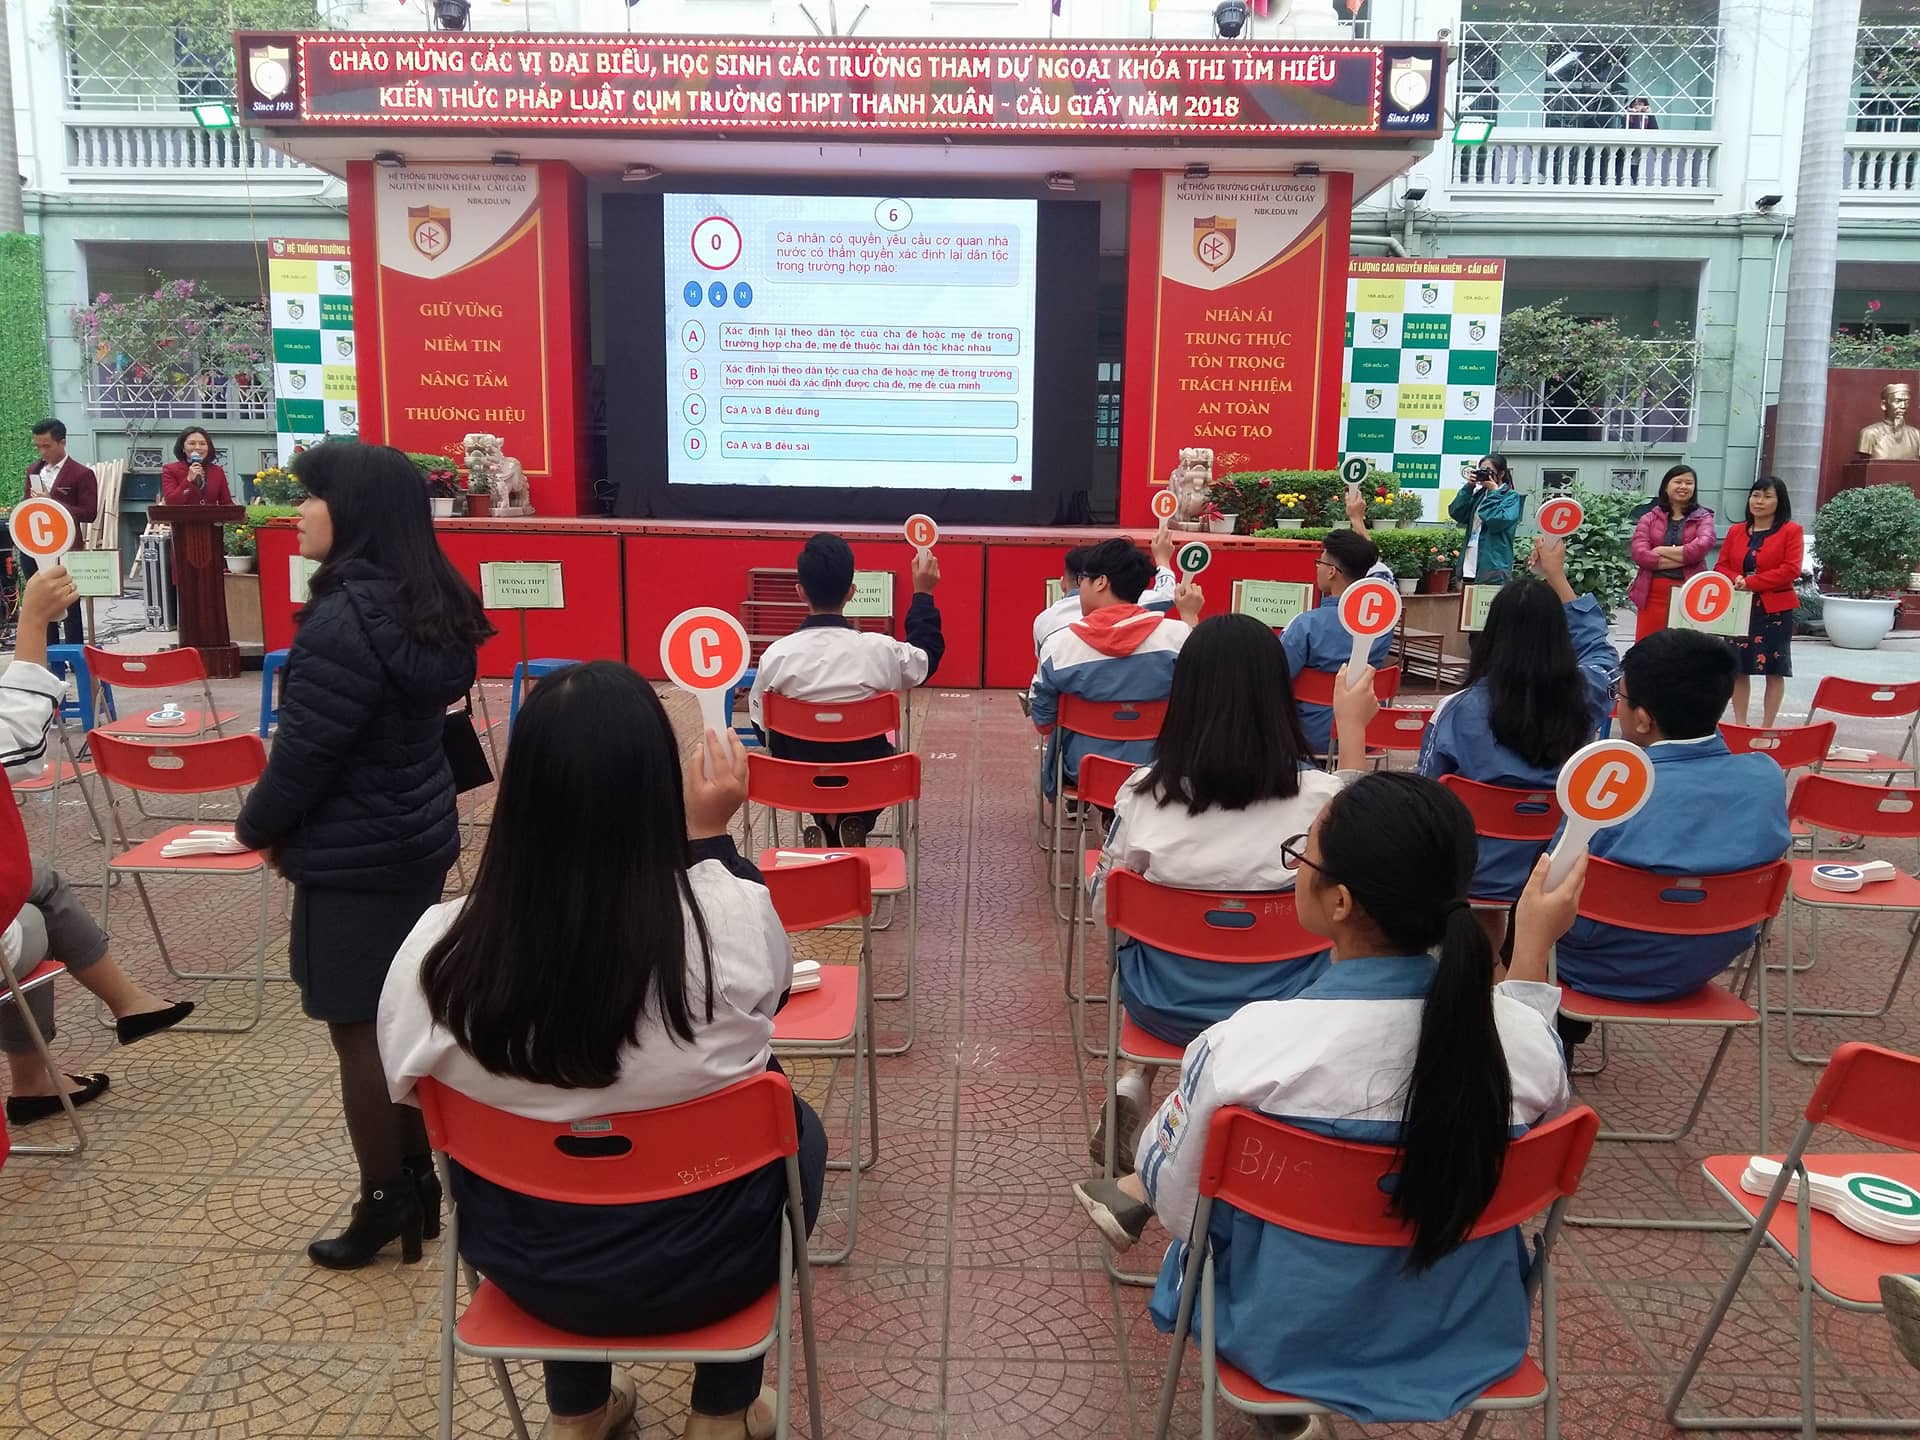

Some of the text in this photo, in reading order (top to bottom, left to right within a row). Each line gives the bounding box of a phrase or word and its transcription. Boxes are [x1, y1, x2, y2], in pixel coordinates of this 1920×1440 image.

[329, 41, 1336, 82] CHÀO MỪNG CÁC VỊ ĐẠI BIỂU, HỌC SINH CÁC TRƯỜNG THAM DỰ NGOẠI KHÓA THI TÌM HIỂU
[252, 101, 294, 111] Since 1993
[379, 80, 1239, 117] KIẾN THỨC PHÁP LUẬT CỤM TRƯỜNG THPT THANH XUÂN CẦU GIẤY NĂM 2018
[1387, 113, 1430, 123] Since 1993
[1300, 184, 1316, 192] CAO
[890, 208, 898, 222] 6
[711, 234, 721, 250] 0
[956, 237, 983, 247] quan
[777, 261, 804, 274] trong
[1382, 262, 1395, 272] CAO
[690, 290, 747, 299] H N
[420, 301, 503, 318] GIỮ VỮNG
[1205, 307, 1273, 322] NHÂN ÁI
[424, 333, 501, 352] NIỀM TIN
[688, 330, 698, 342] A
[791, 328, 812, 337] theo
[883, 329, 901, 338] cha
[987, 331, 1013, 342] trong
[1185, 331, 1292, 348] TRUNG THỰC
[785, 340, 802, 349] cha
[968, 343, 991, 352] nhau
[1188, 353, 1285, 372] TÔN TRỌNG
[420, 369, 508, 387] NÂNG TẦM
[690, 368, 698, 380] B
[782, 365, 802, 374] theo
[862, 368, 878, 376] cha
[952, 368, 977, 379] trong
[747, 378, 763, 386] con
[873, 380, 889, 388] cha
[1179, 376, 1293, 395] TRÁCH NHIỆM
[690, 403, 699, 415] C
[741, 406, 748, 414] A
[765, 406, 772, 414] B
[1198, 399, 1270, 414] AN TOÀN
[405, 406, 525, 424] THƯƠNG HIỆU
[1194, 422, 1272, 440] SÁNG TẠO
[690, 438, 700, 449] D
[741, 441, 748, 449] A
[765, 441, 772, 449] B
[796, 442, 810, 450] sai
[1350, 461, 1361, 479] C
[1160, 496, 1171, 514] C
[1551, 507, 1571, 529] C
[29, 511, 54, 547] C
[915, 522, 928, 542] C
[1187, 549, 1202, 568] C
[1696, 583, 1720, 615] C
[1358, 592, 1383, 627] C
[689, 627, 723, 678] C
[1586, 761, 1631, 810] C
[1859, 1182, 1912, 1208] D
